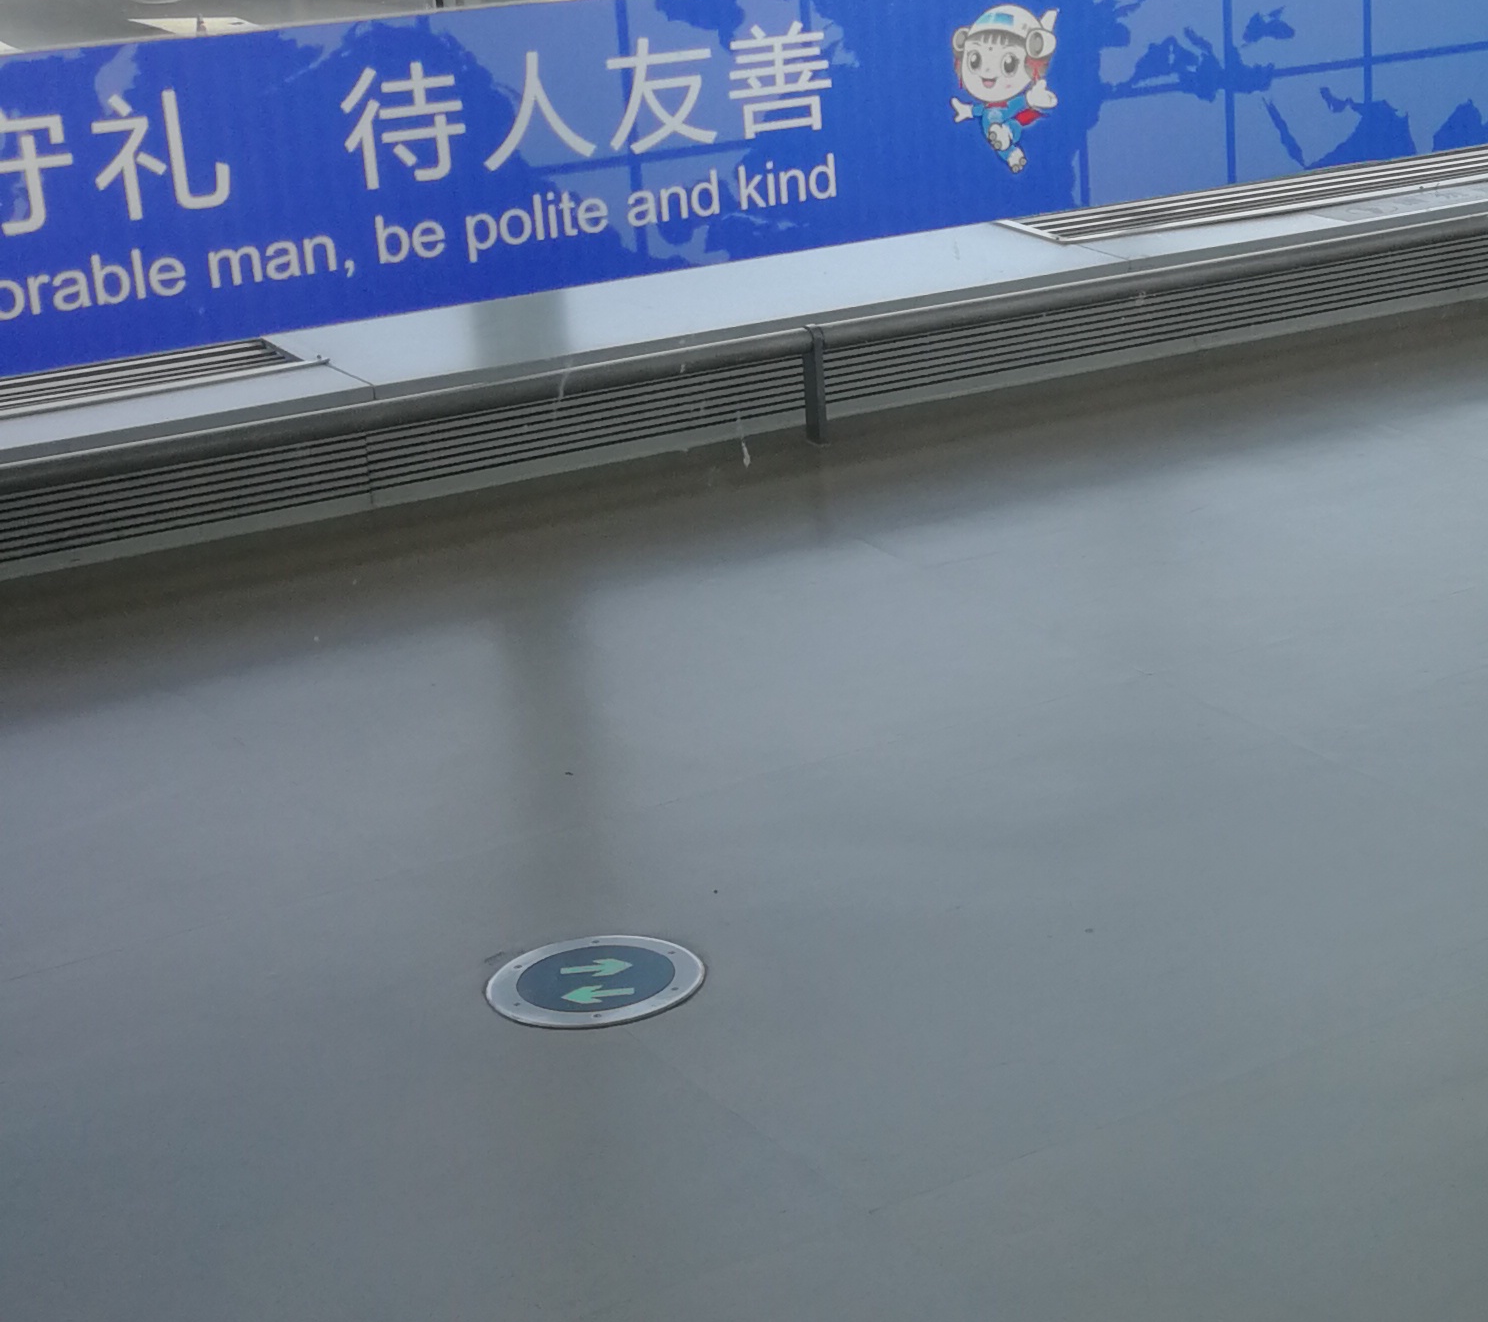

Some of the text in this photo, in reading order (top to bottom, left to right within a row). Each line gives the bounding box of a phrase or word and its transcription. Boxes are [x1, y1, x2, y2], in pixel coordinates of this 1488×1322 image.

[340, 20, 833, 190] 待人友善
[208, 234, 355, 289] man,
[375, 215, 446, 264] be
[465, 190, 609, 263] polite
[627, 168, 721, 226] and
[737, 153, 838, 211] kind
